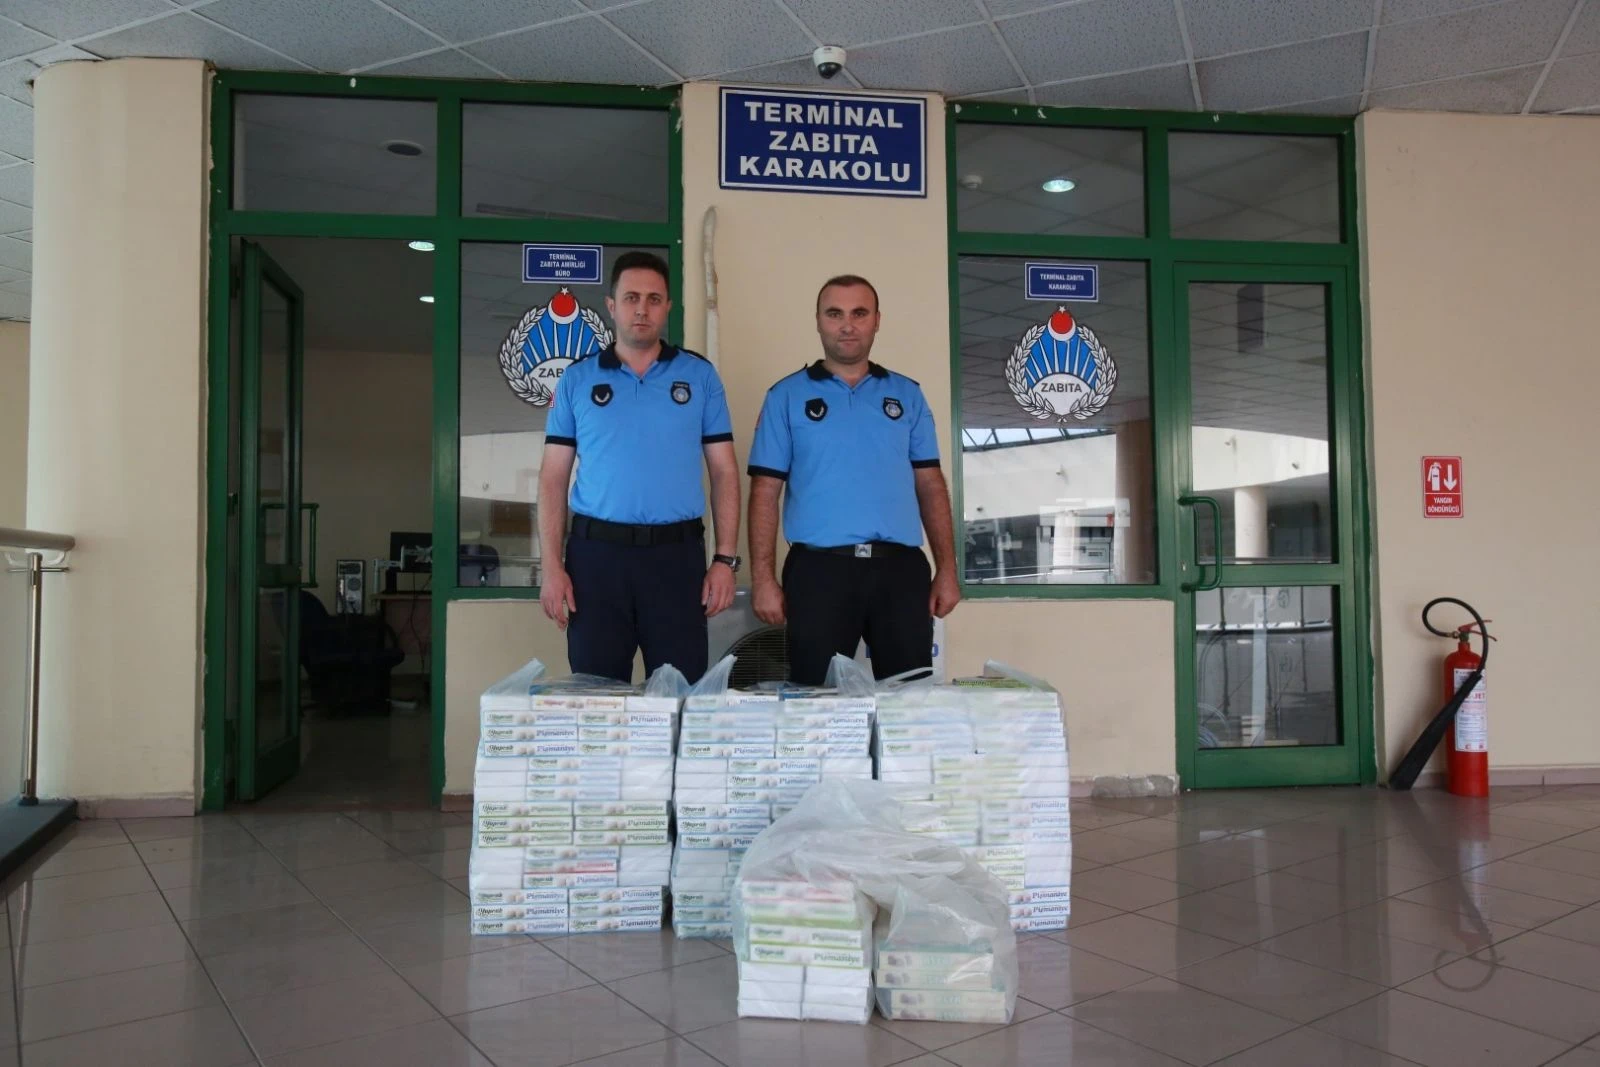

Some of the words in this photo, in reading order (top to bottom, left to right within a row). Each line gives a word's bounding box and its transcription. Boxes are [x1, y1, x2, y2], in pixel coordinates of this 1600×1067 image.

[744, 101, 904, 128] TERMİNAL
[769, 131, 879, 155] ZABITA
[739, 156, 911, 183] KARAKOLU
[538, 368, 565, 378] ZAB
[1041, 383, 1083, 393] ZABITA
